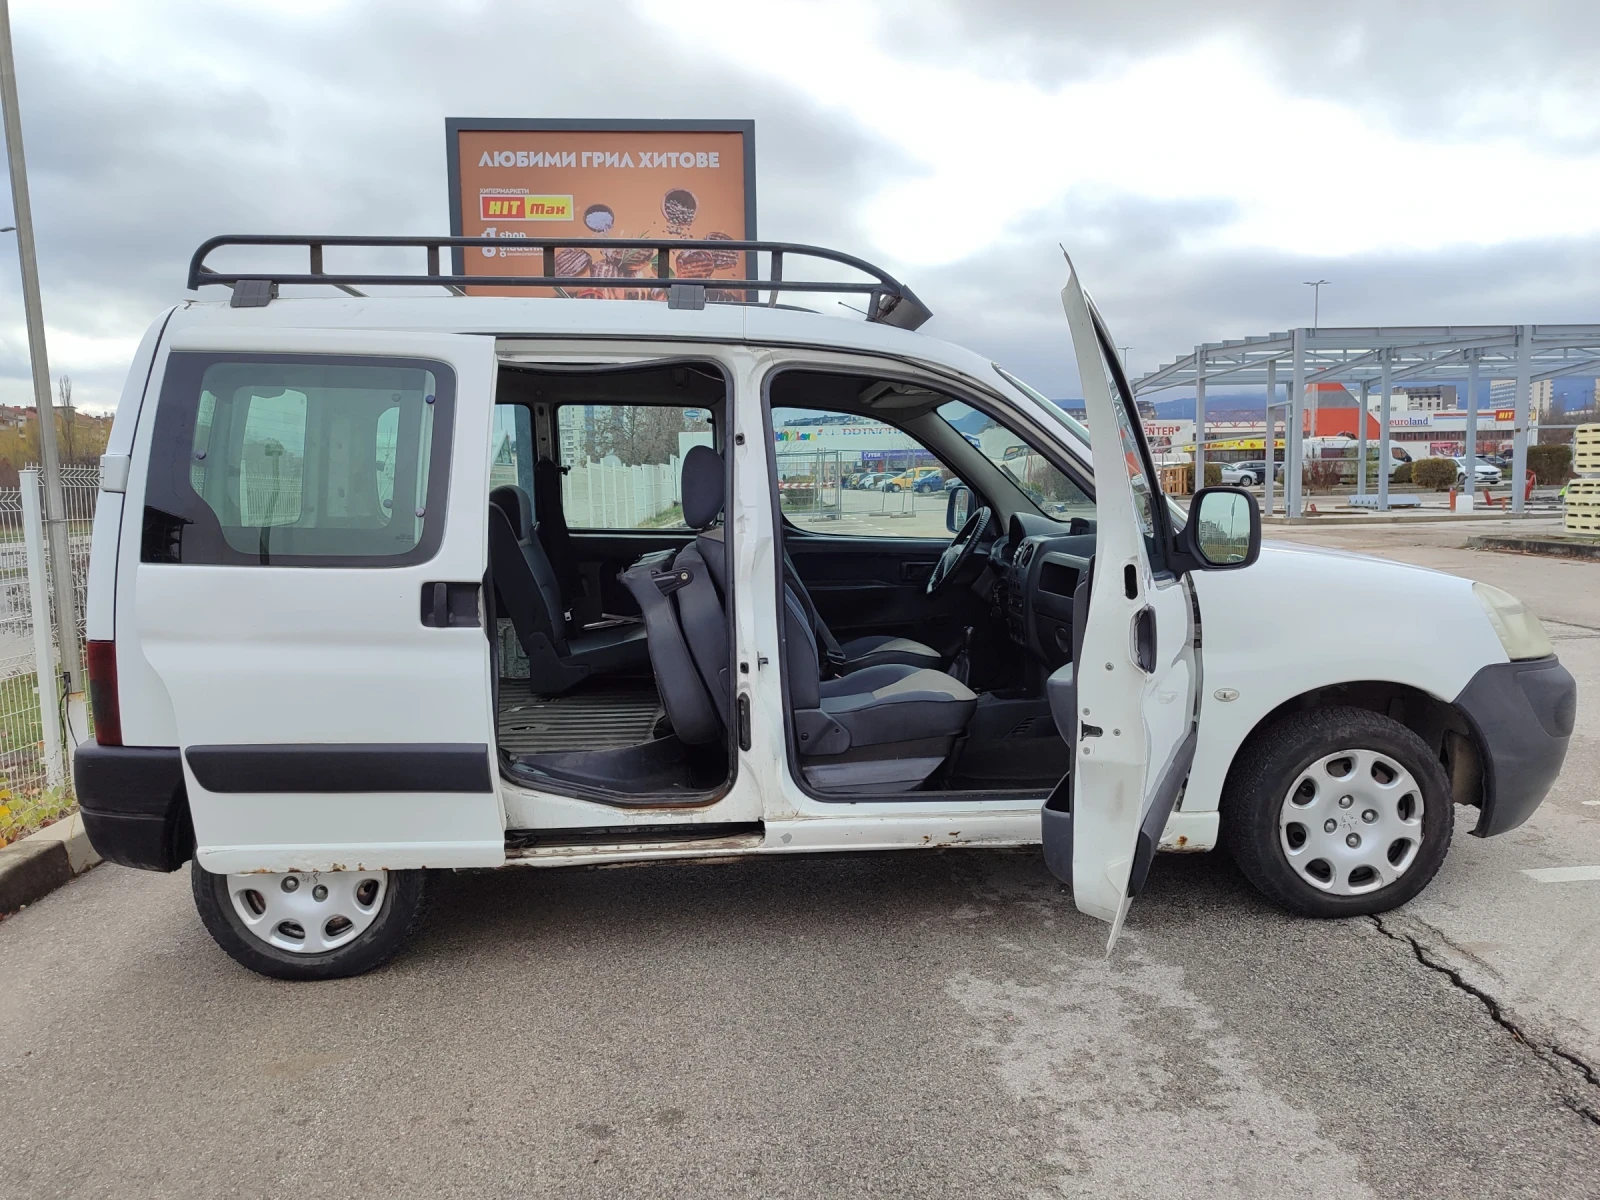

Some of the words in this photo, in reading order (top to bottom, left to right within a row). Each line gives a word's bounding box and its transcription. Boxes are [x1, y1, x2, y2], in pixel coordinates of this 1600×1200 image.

[478, 150, 577, 168] ЛЮБИМИ
[581, 151, 635, 168] ГРИЛ
[638, 151, 720, 168] ХИТОВЕ
[488, 200, 521, 215] HIT
[1389, 416, 1429, 426] euroland
[1498, 411, 1514, 419] HIT
